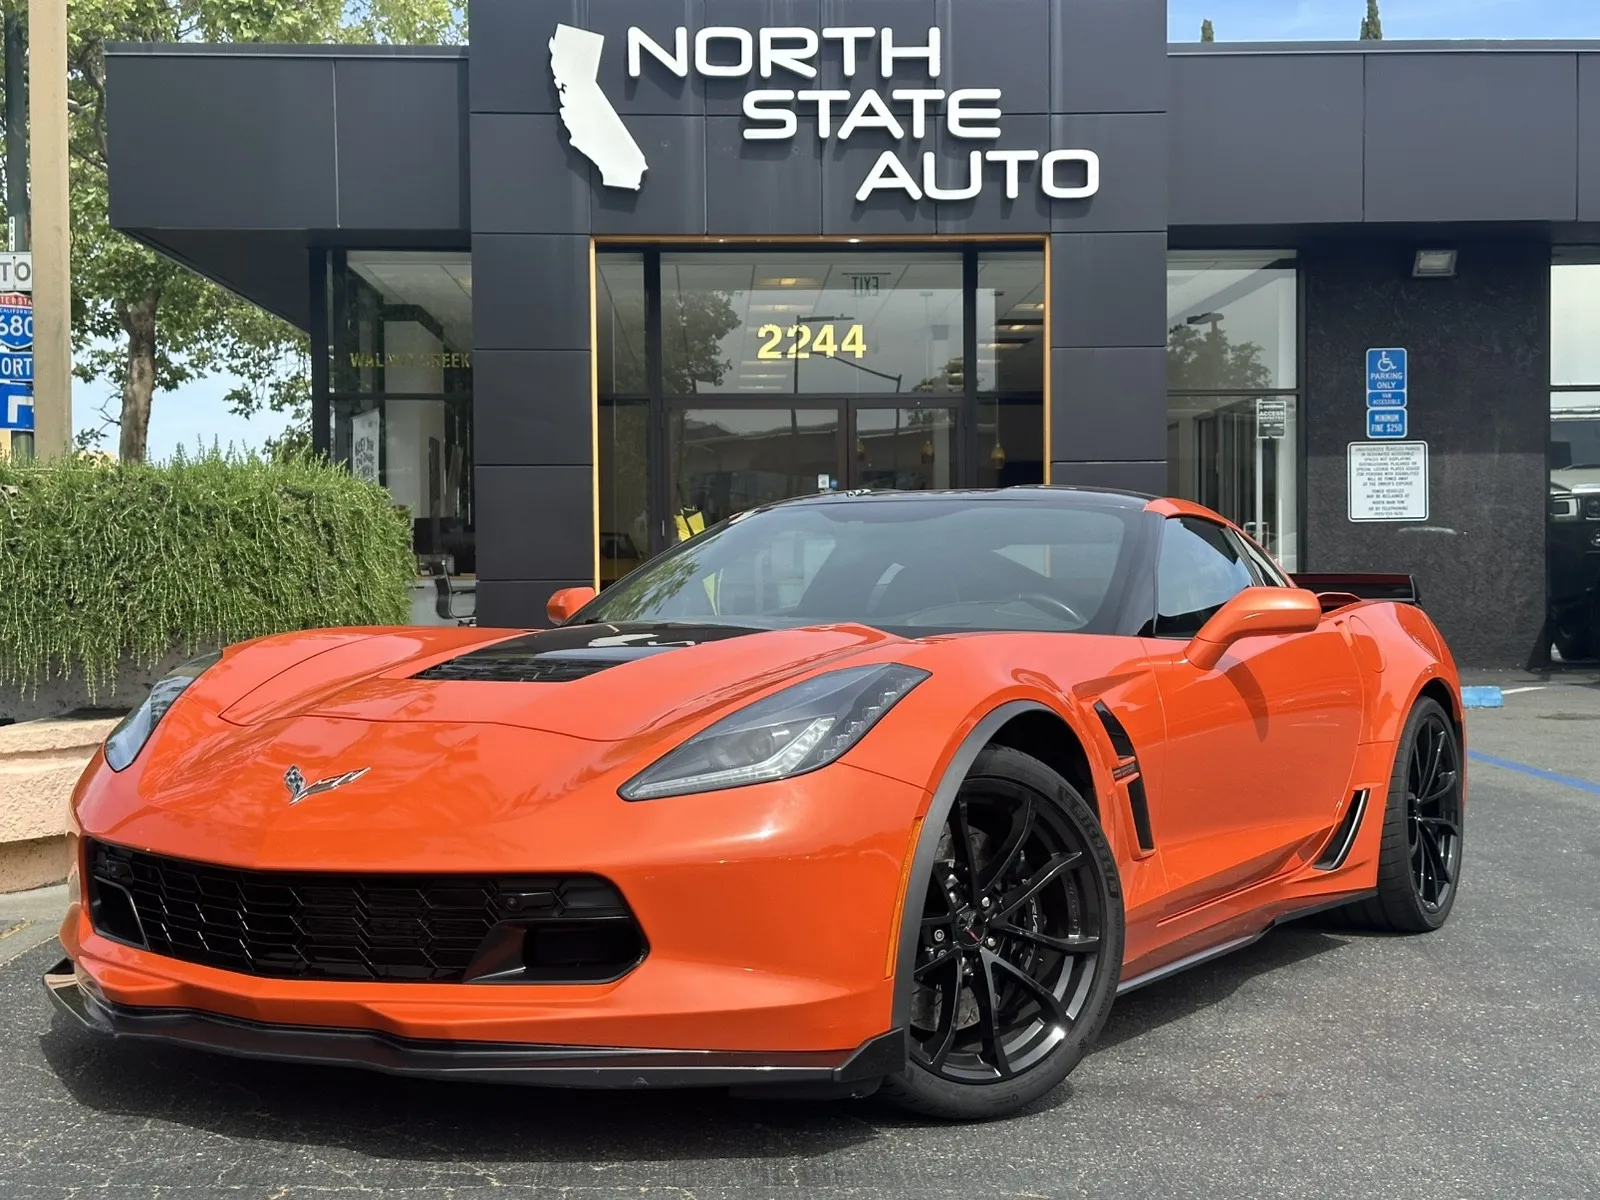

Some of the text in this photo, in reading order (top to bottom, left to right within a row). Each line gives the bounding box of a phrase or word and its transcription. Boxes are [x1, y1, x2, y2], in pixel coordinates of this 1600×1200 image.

[627, 26, 941, 79] NORTH
[742, 88, 1002, 140] STATE
[855, 149, 1100, 202] AUTO
[0, 262, 31, 282] TO
[1, 296, 32, 306] TERSTA
[0, 315, 32, 337] 680
[756, 323, 867, 359] 2244
[1, 357, 32, 376] ORT
[1370, 372, 1403, 380] PARKING
[1376, 381, 1396, 389] ONLY
[1374, 414, 1400, 422] MINIMUM
[1371, 424, 1403, 432] FINE $250
